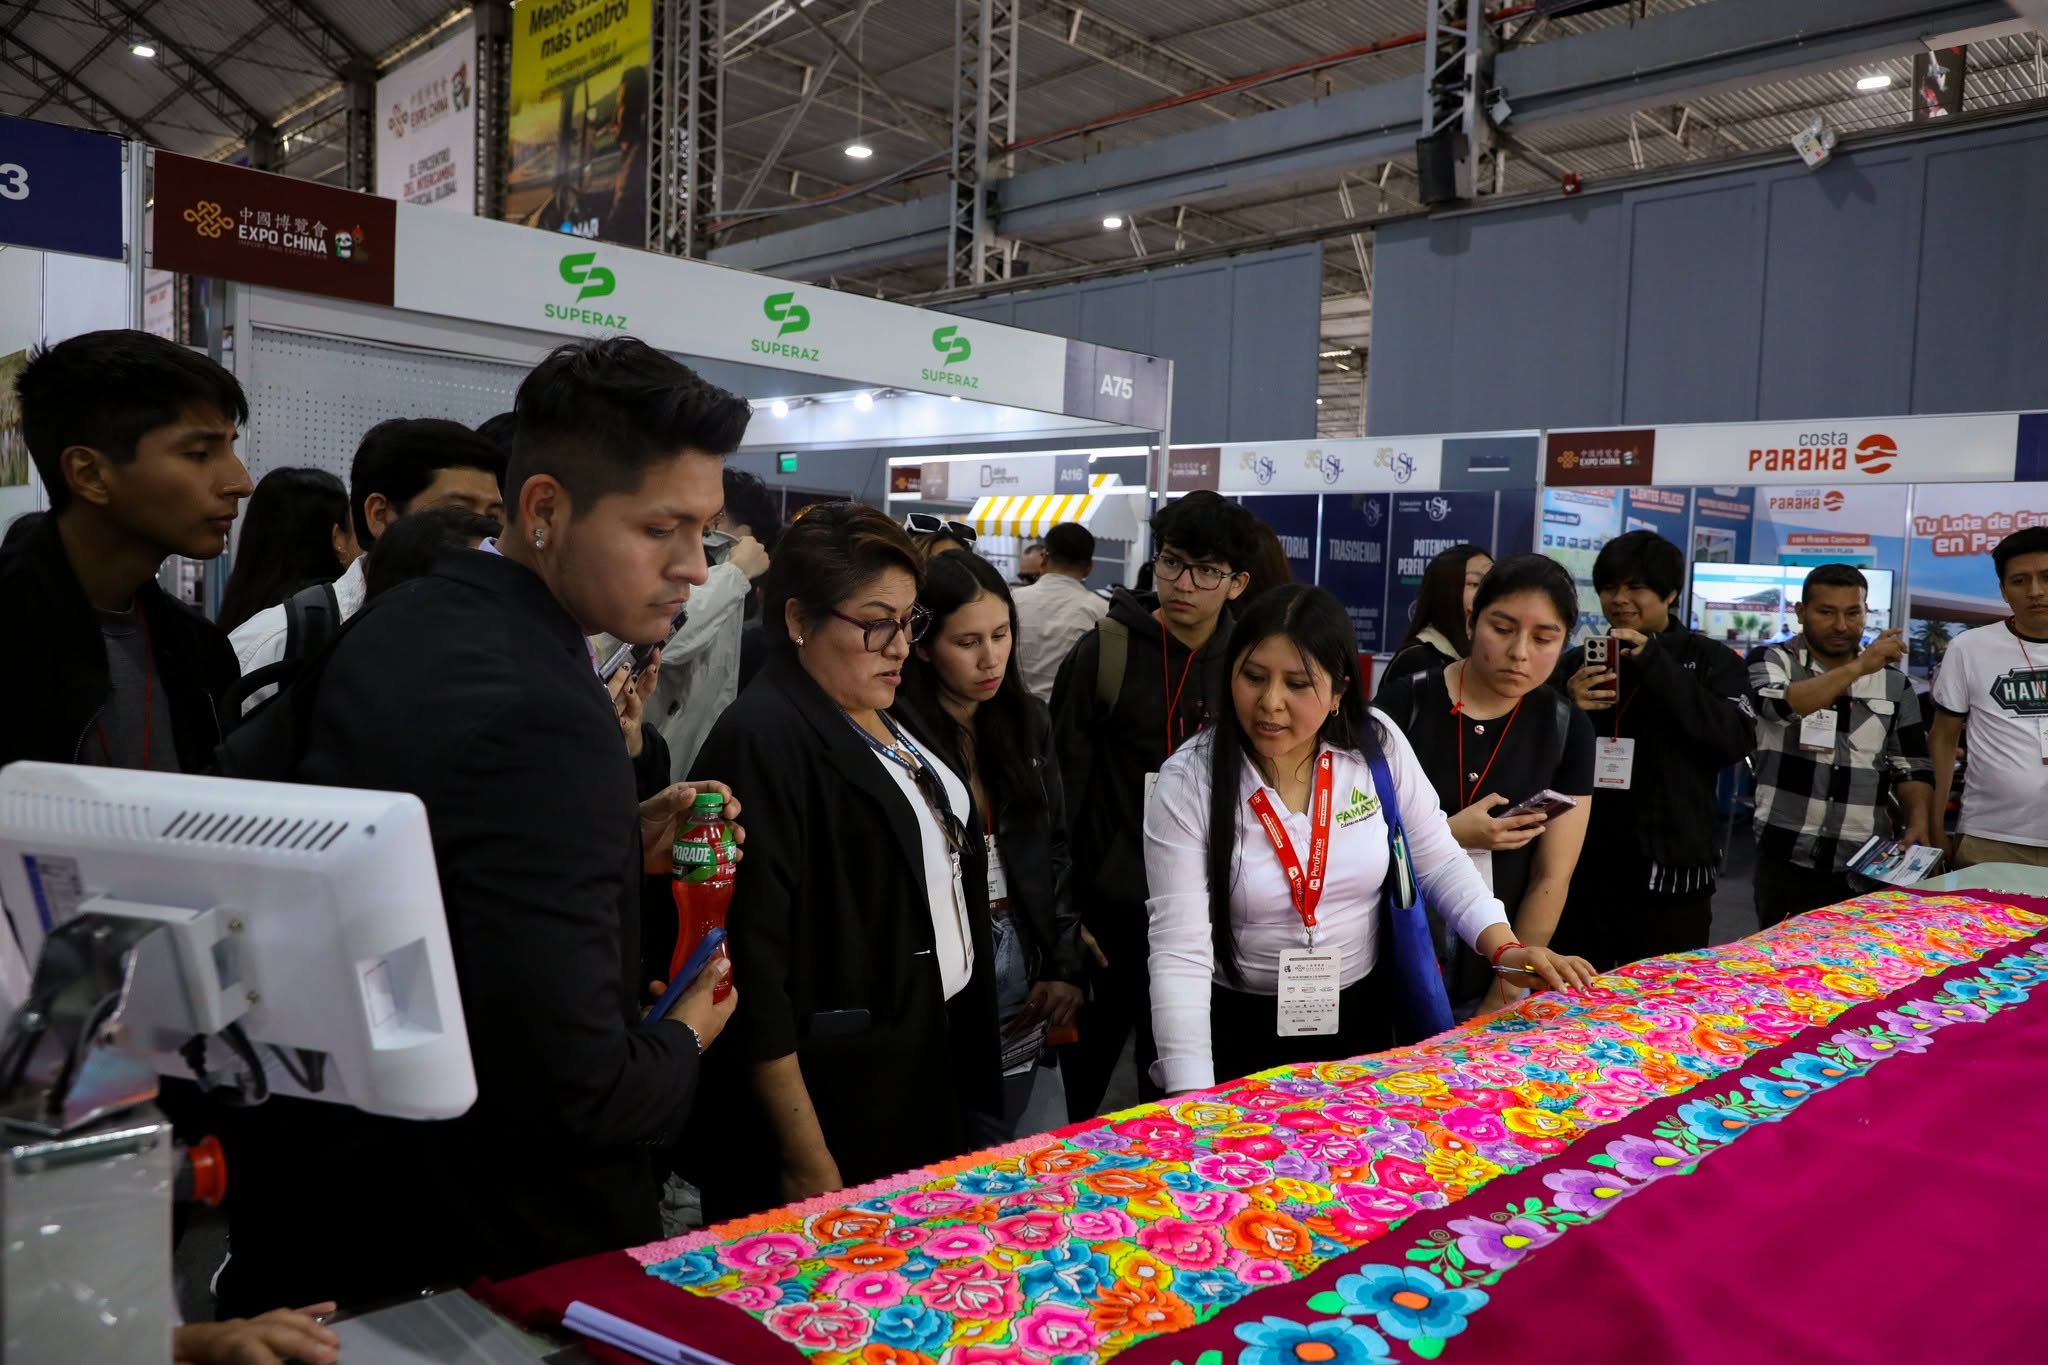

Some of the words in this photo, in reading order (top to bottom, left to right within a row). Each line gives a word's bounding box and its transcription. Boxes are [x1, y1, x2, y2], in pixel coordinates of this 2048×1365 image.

[575, 0, 629, 42] control
[238, 224, 279, 246] EXPO
[282, 232, 328, 254] CHINA
[544, 303, 628, 330] SUPERAZ
[751, 338, 820, 362] SUPERAZ
[921, 368, 979, 389] SUPERAZ
[1100, 374, 1133, 400] A75
[1798, 431, 1848, 447] costa
[1579, 457, 1599, 466] EXPO
[1599, 457, 1621, 466] CHINA
[1916, 518, 1938, 533] Tu
[1942, 516, 1982, 532] Lote
[1988, 514, 2012, 529] de
[1276, 534, 1309, 560] TORIA
[1935, 537, 1965, 553] en
[1397, 557, 1425, 576] PERFIL
[672, 845, 711, 862] PORADE
[1310, 837, 1322, 877] PerúFerias
